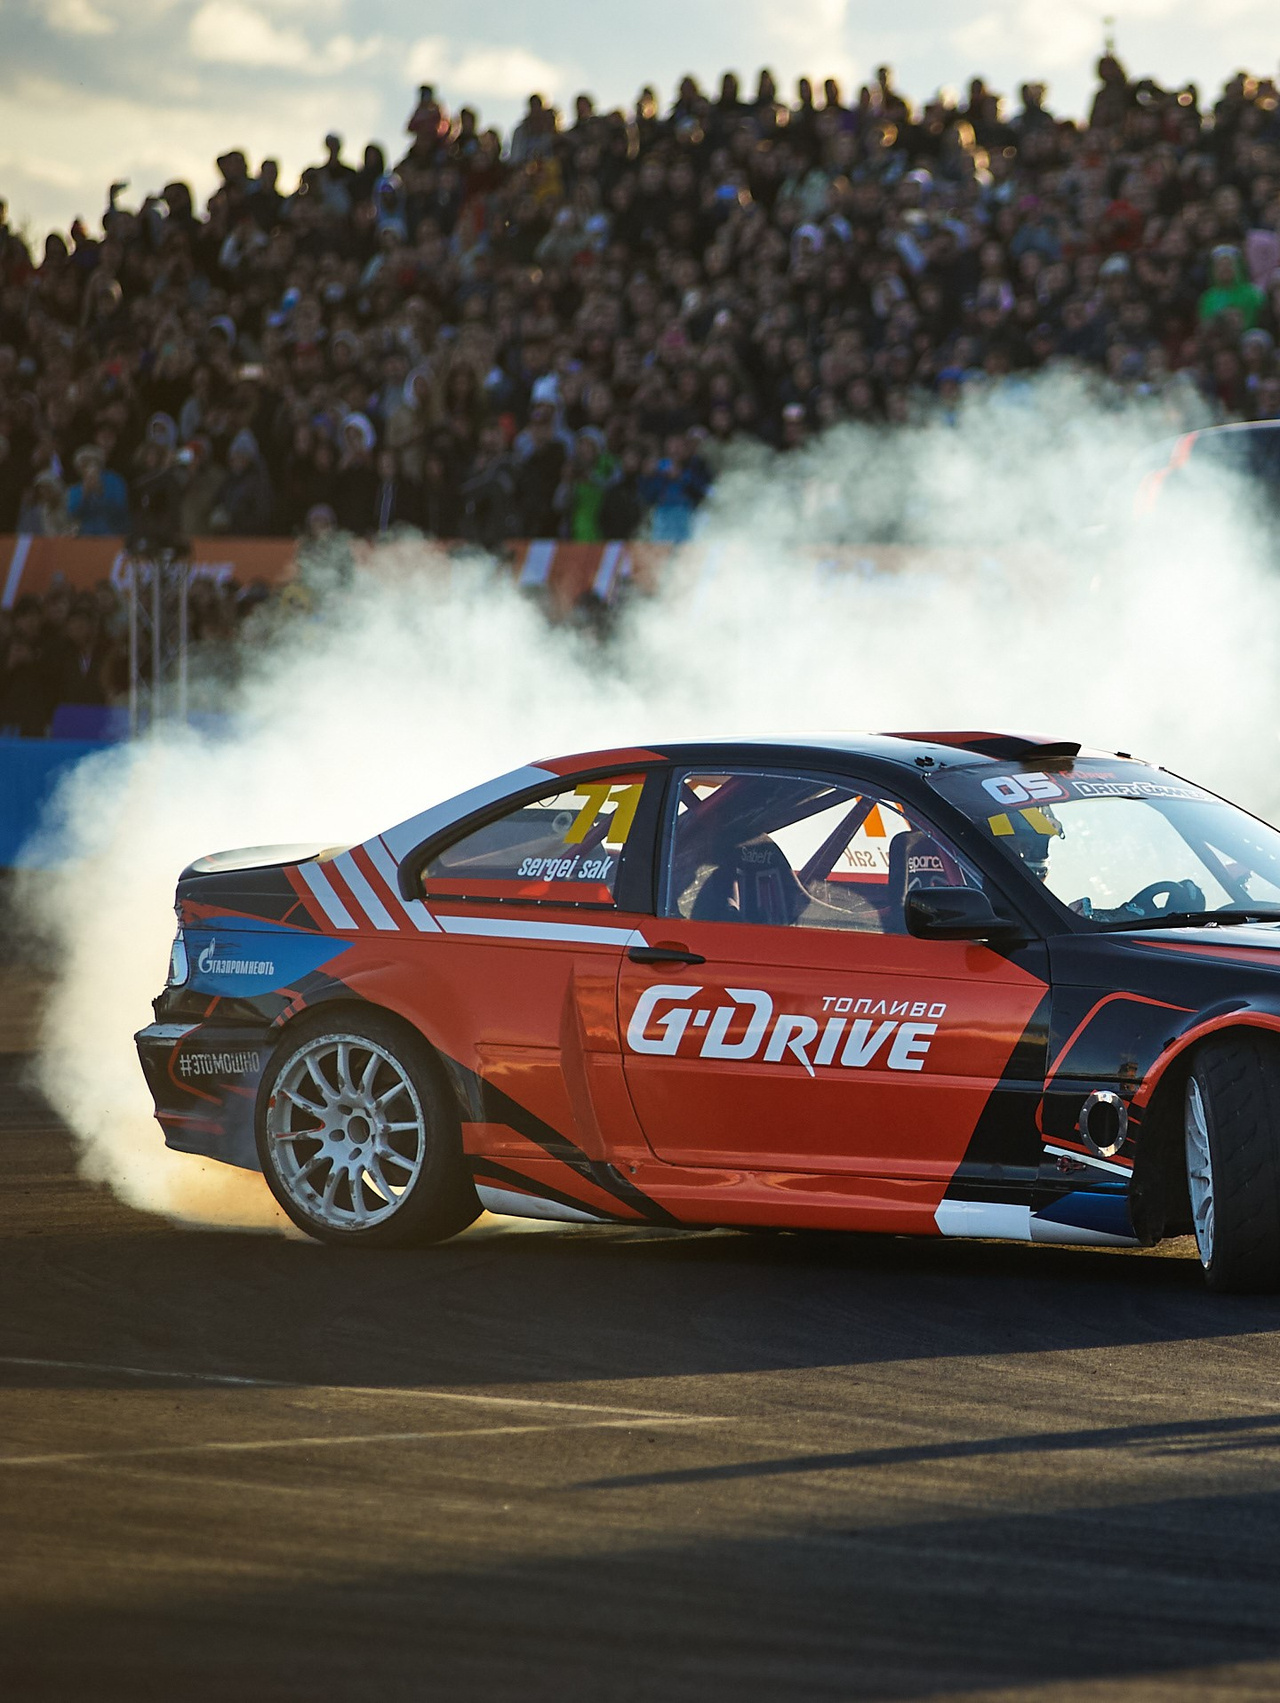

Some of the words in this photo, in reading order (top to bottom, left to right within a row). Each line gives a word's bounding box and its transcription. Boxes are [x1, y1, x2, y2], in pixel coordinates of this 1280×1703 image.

[981, 771, 1064, 804] 05
[563, 784, 644, 843] 71
[517, 854, 580, 882] sergei
[577, 856, 614, 879] sak
[822, 996, 946, 1018] ТОПЛИВО
